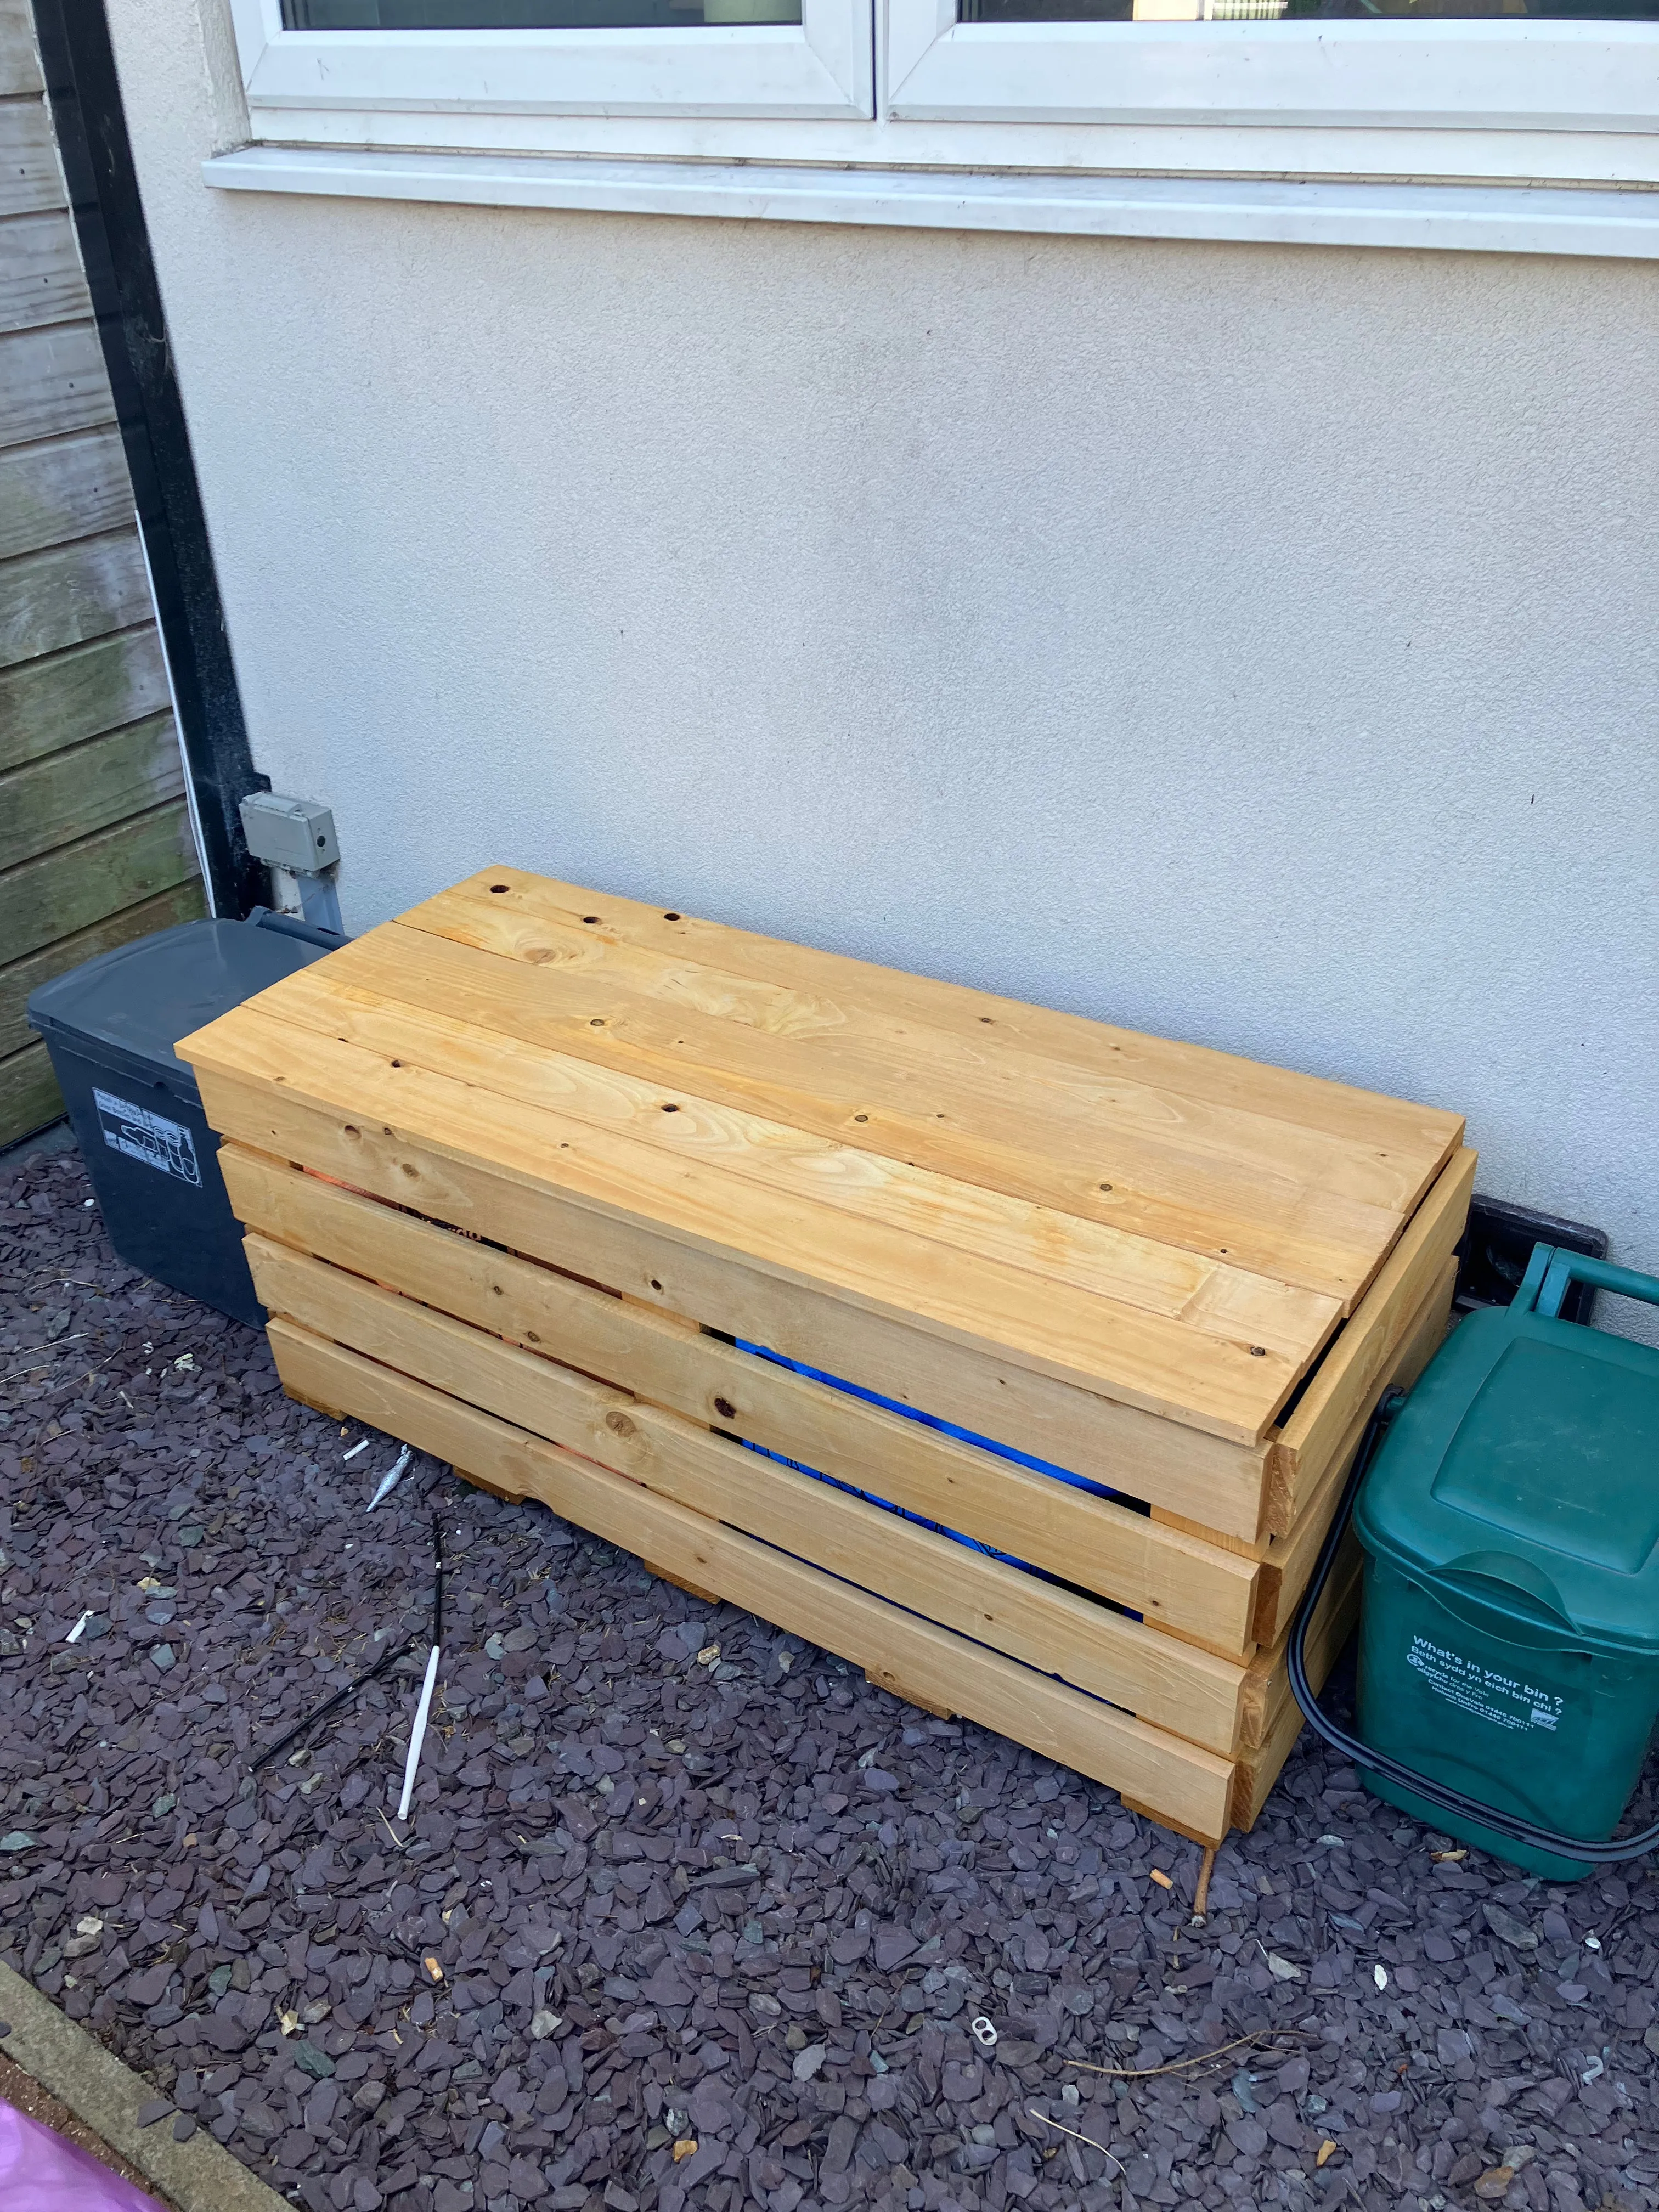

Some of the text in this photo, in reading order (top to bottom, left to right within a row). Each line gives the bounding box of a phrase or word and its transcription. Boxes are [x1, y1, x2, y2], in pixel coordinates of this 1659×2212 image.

[1412, 1645, 1436, 1662] Beth
[1438, 1660, 1466, 1676] sydd
[1467, 1673, 1482, 1683] yn
[1485, 1681, 1509, 1695] eich
[1511, 1691, 1530, 1703] bin
[1533, 1701, 1551, 1712] chi
[1414, 1635, 1564, 1706] What's in your bin ?
